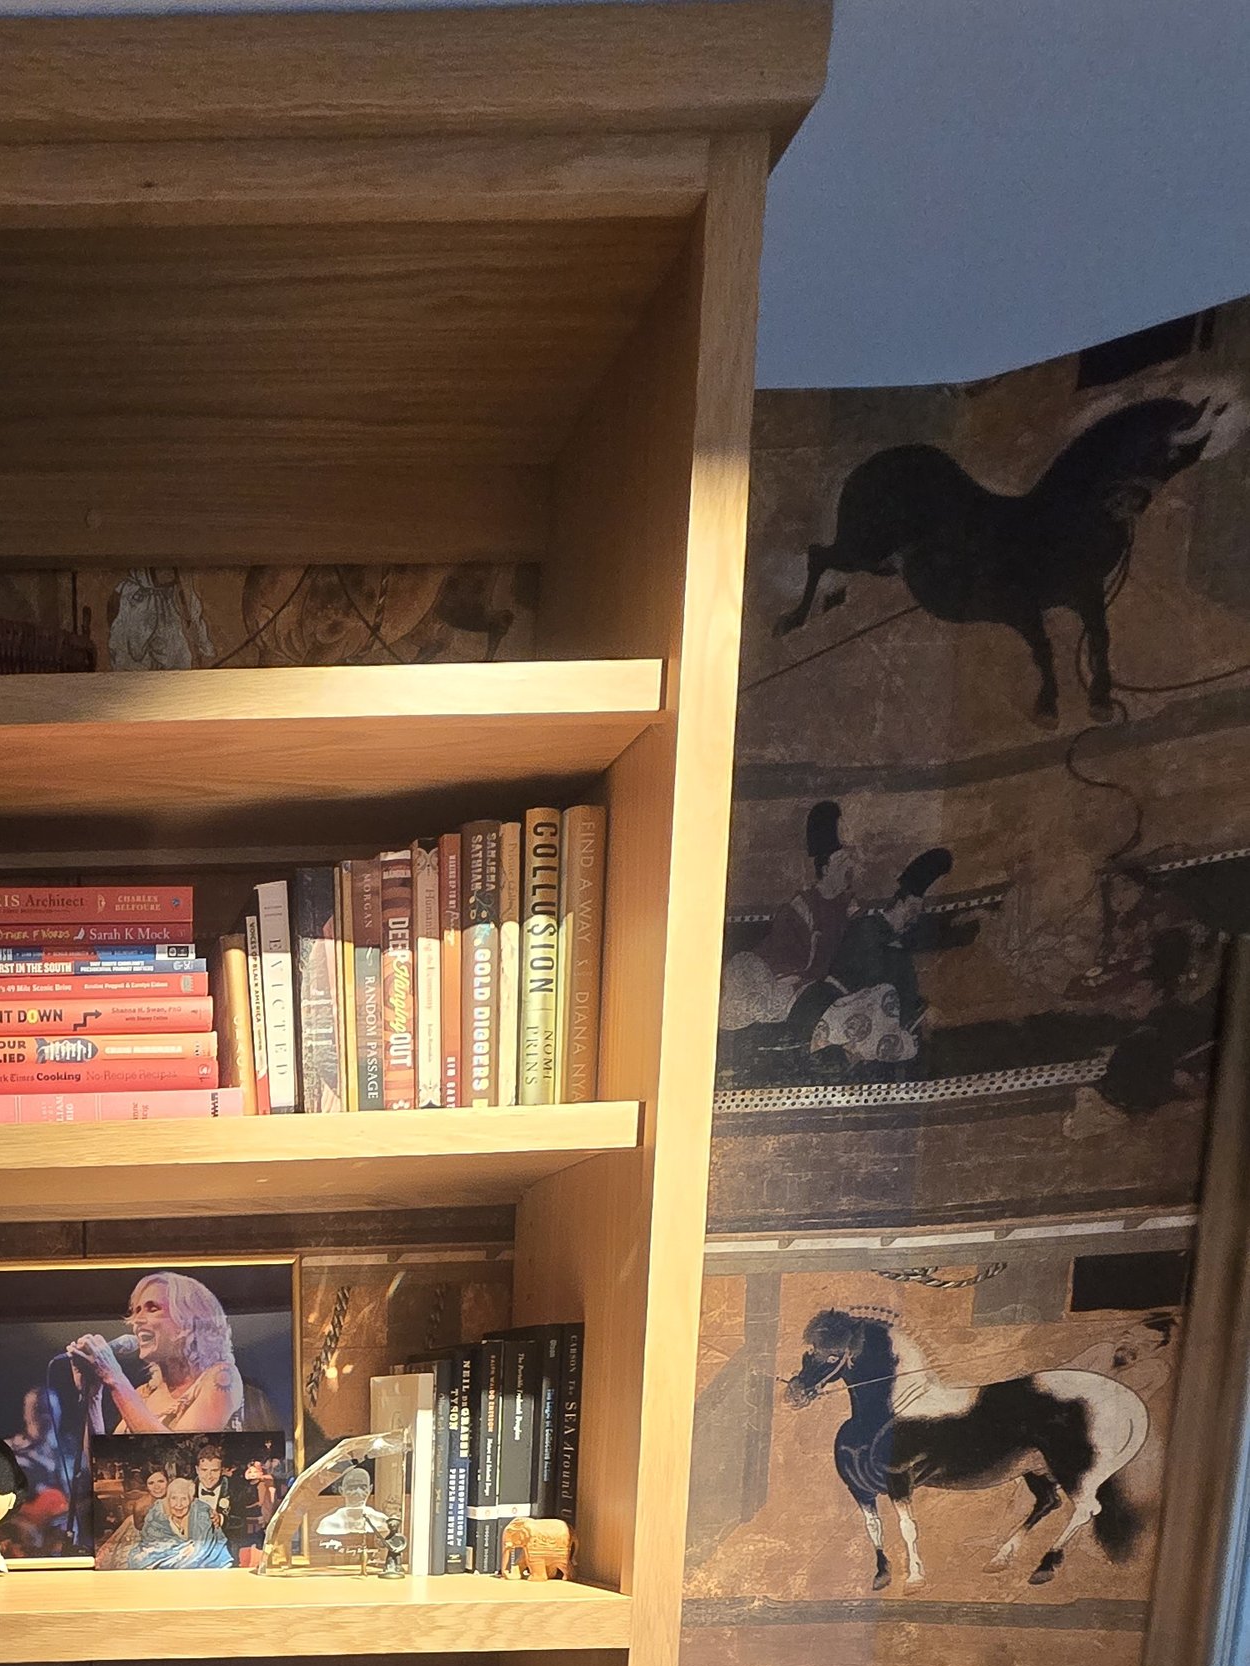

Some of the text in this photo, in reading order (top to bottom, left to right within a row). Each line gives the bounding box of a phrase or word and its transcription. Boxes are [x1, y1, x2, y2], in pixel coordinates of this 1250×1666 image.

[25, 893, 85, 908] Architect
[528, 821, 558, 994] COLLUSION
[89, 927, 170, 940] Sarah K Mock
[18, 1008, 64, 1024] DOWN
[268, 938, 289, 1077] EVICTED
[362, 873, 379, 1100] MORGAN RANDOM PASSAGE
[387, 917, 412, 1067] DEEP Hanging OUT
[472, 948, 491, 1092] GOLD DIGGERS
[525, 1024, 540, 1086] PRINS
[542, 1029, 555, 1081] NOMI
[448, 1388, 460, 1431] TYSON
